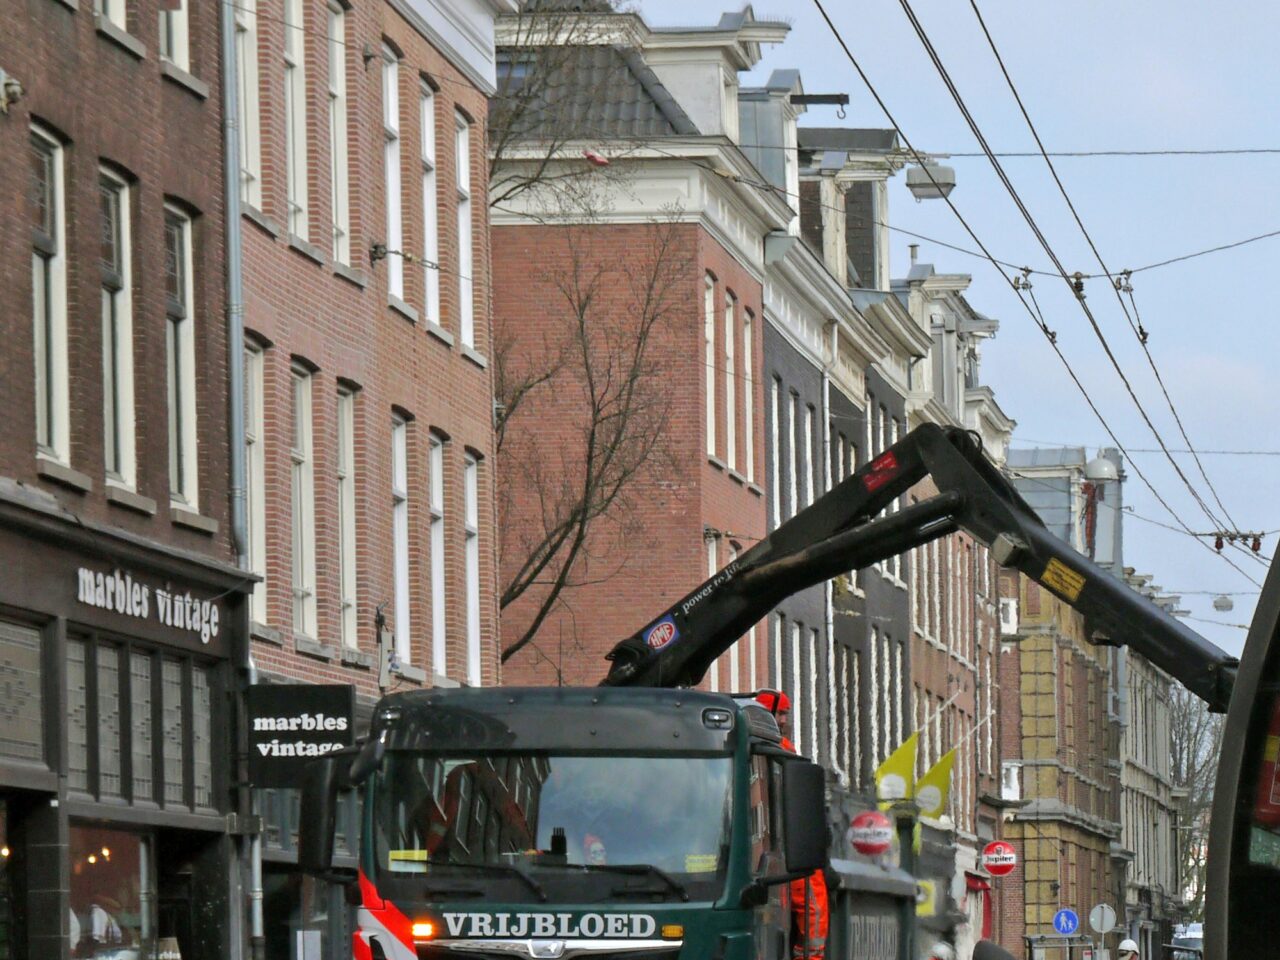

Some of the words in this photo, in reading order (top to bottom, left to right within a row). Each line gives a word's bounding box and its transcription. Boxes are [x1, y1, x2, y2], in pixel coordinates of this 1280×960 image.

[78, 567, 149, 619] marbles
[155, 582, 219, 644] vintage
[682, 584, 713, 614] power
[650, 623, 672, 647] HMF
[253, 713, 348, 731] marbles
[443, 913, 656, 937] VRIJBLOED
